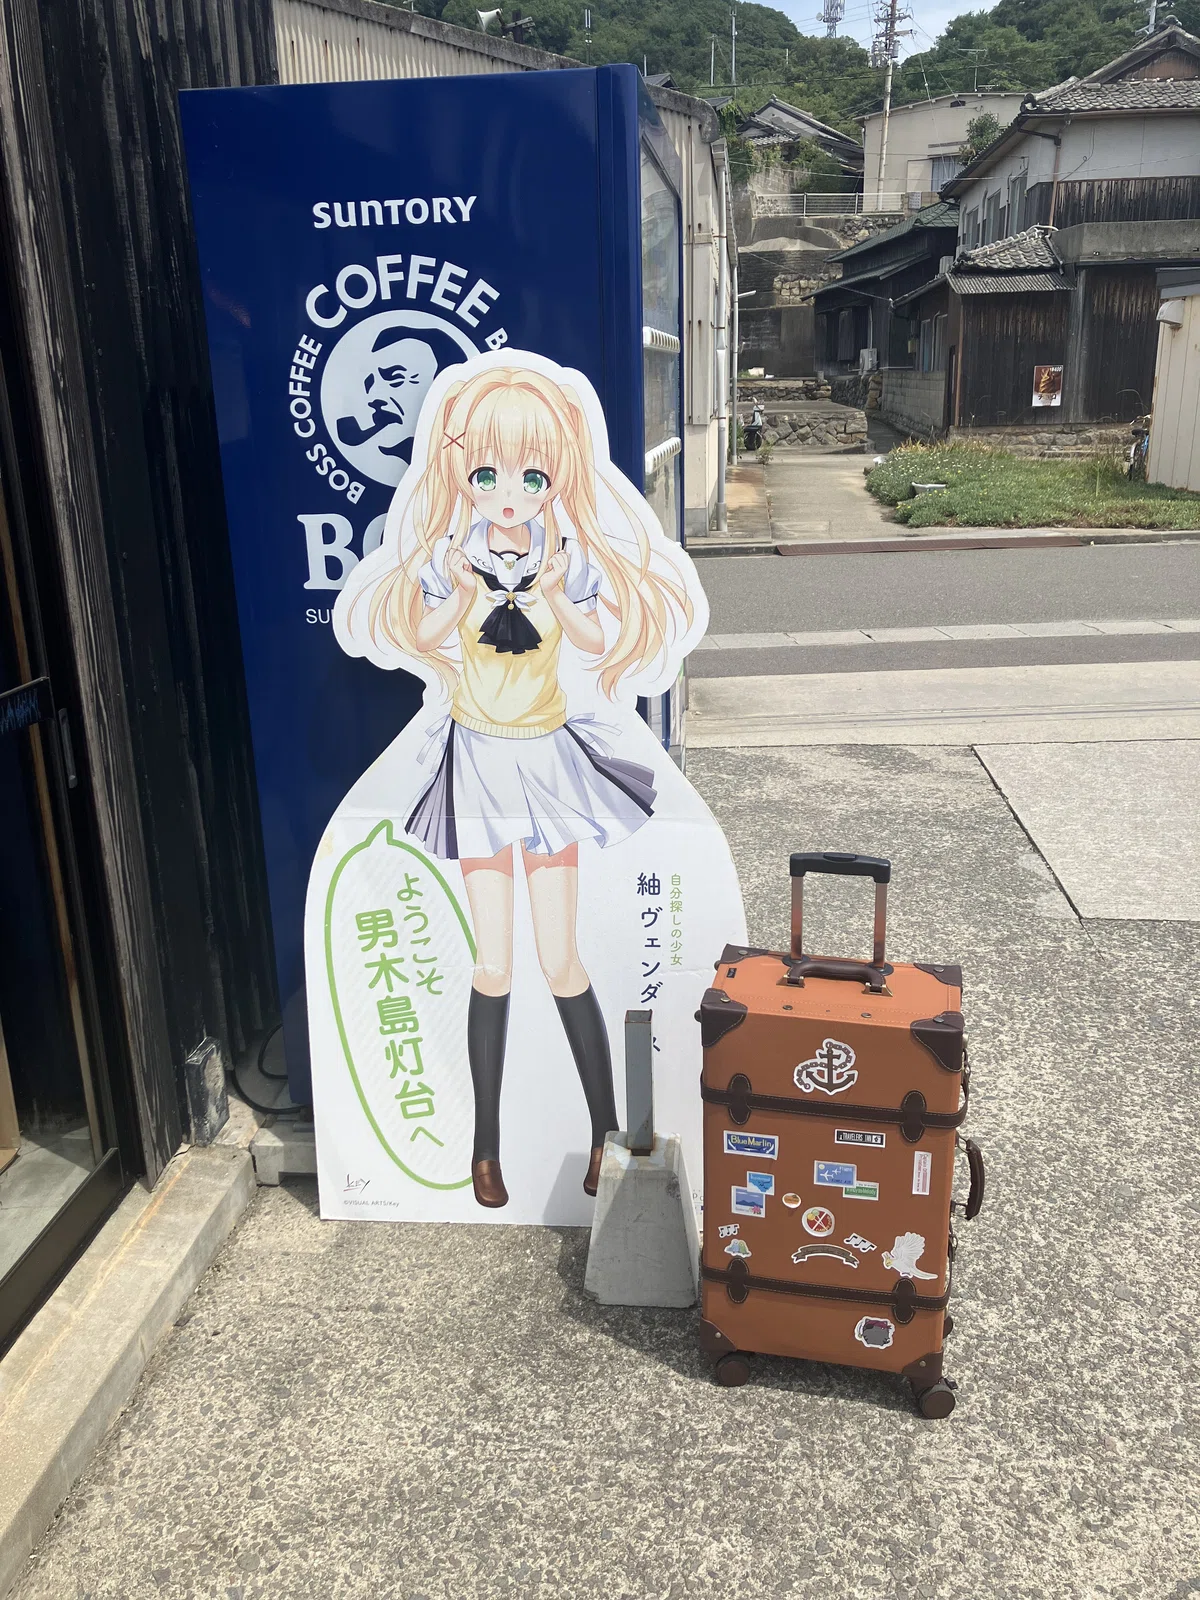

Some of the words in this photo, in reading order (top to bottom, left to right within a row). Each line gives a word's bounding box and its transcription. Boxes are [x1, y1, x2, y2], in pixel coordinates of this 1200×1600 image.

[305, 253, 500, 329] COFFEE
[288, 333, 322, 438] COFFEE
[305, 441, 366, 505] BOSS
[305, 608, 335, 624] SU
[396, 872, 444, 996] ようこそ
[669, 873, 683, 966] 自分探しの少女
[355, 908, 445, 1148] 男木島灯台へ
